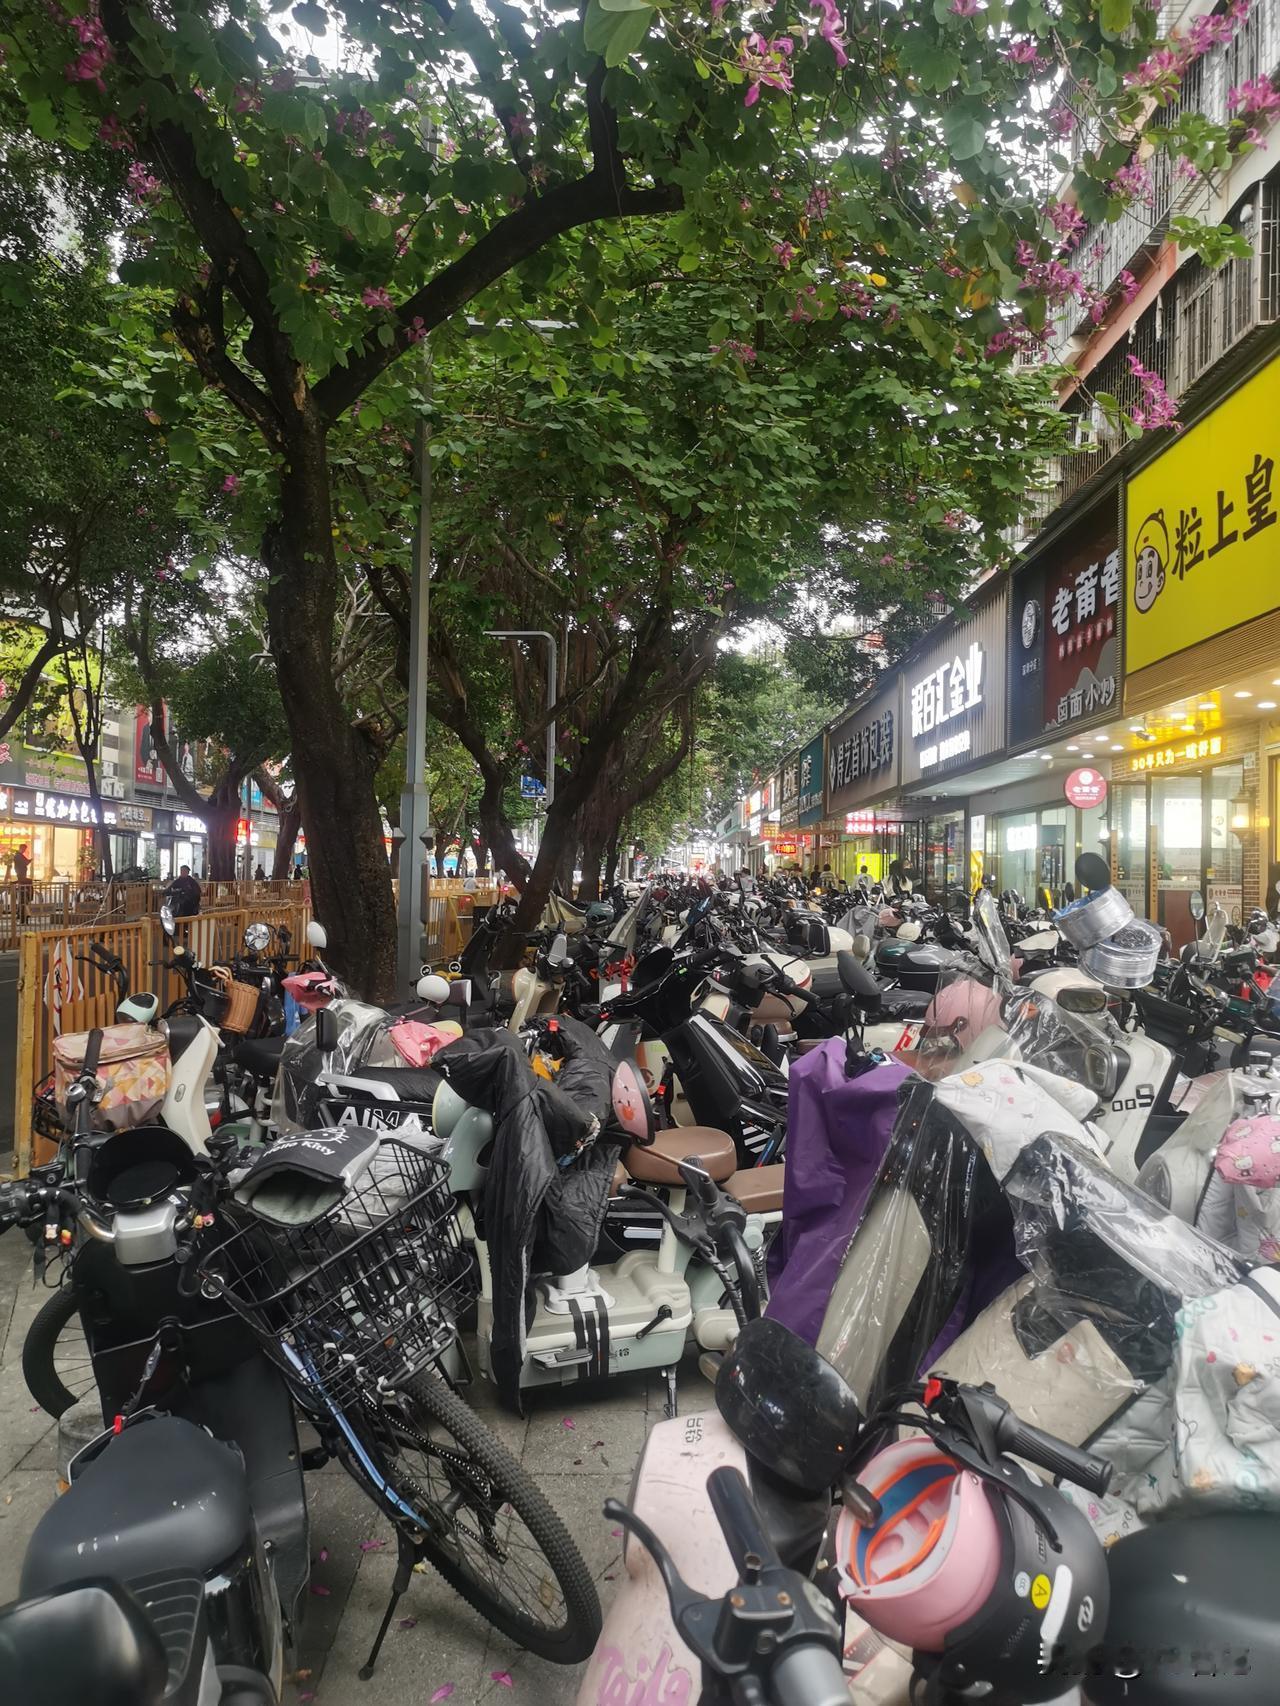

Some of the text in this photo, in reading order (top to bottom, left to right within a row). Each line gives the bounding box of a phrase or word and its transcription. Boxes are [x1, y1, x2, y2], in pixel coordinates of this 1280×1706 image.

[1171, 453, 1277, 581] 粒上皇
[1057, 675, 1115, 724] 卤面小炒
[301, 1140, 335, 1156] Kitty
